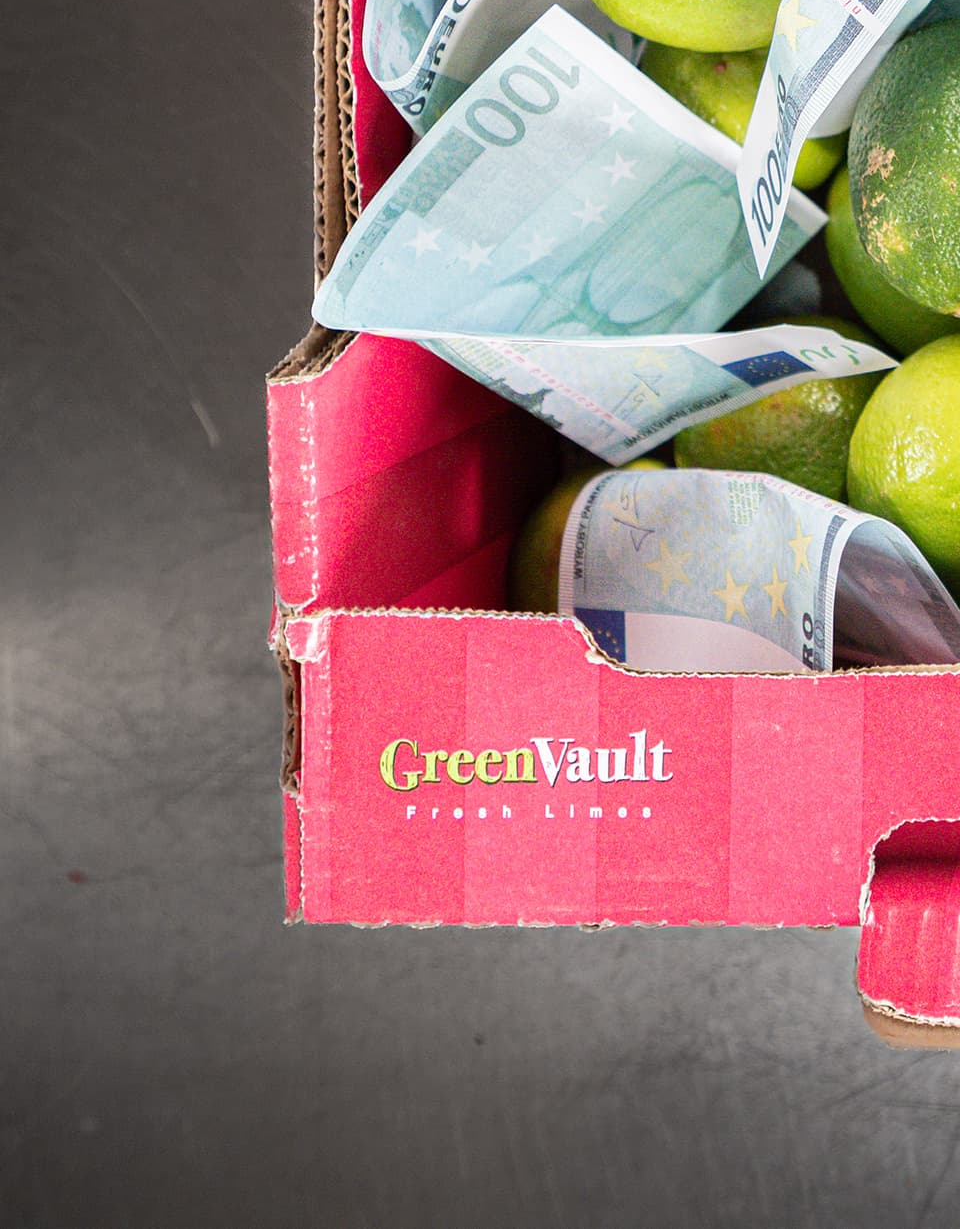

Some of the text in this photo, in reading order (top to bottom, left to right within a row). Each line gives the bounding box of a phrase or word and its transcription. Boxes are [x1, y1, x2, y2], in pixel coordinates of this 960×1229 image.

[402, 18, 457, 116] EURO
[464, 46, 581, 148] 100
[751, 149, 784, 247] 100
[573, 524, 588, 580] WYROBY
[379, 728, 674, 792] GreenVault
[406, 804, 652, 820] Fresh Limes
